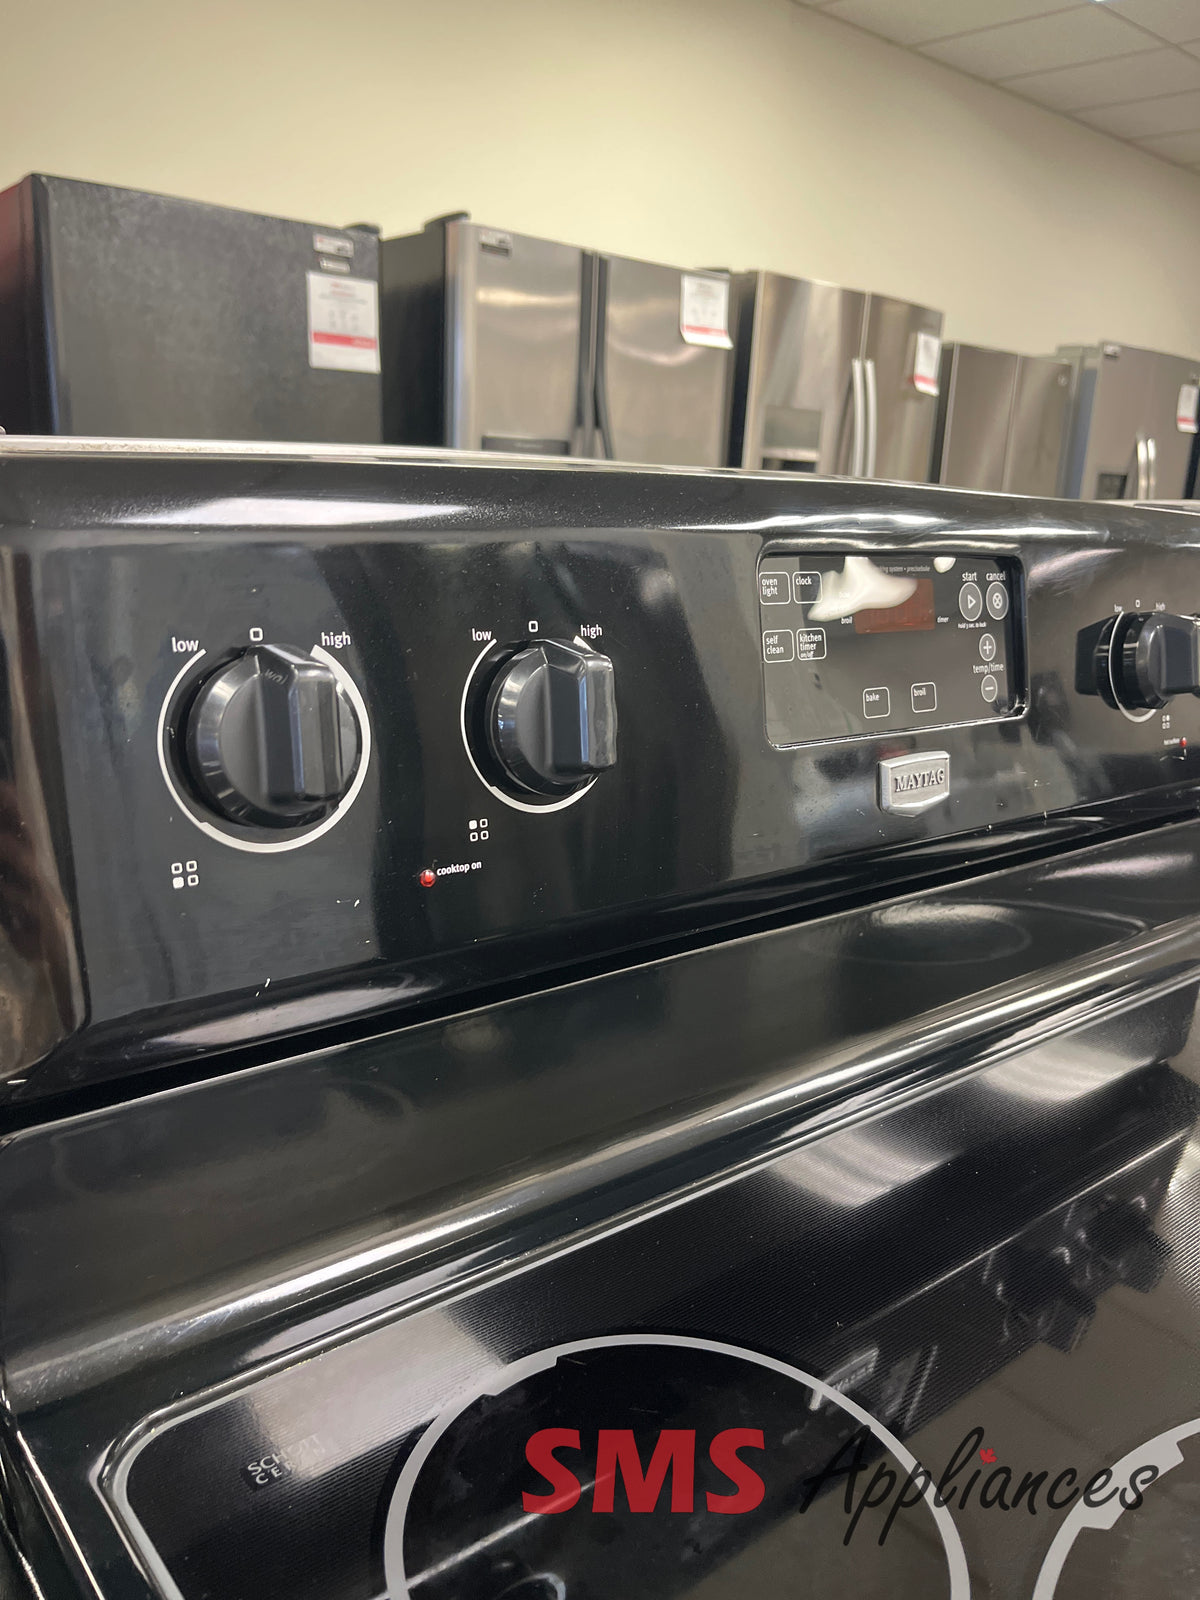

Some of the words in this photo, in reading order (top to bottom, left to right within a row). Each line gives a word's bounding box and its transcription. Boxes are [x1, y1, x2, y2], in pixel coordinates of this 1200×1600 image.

[795, 576, 812, 586] clock
[962, 571, 978, 582] start
[985, 570, 1006, 581] cancel
[761, 578, 778, 586] oven
[762, 586, 778, 597] light
[840, 616, 853, 624] broil
[471, 626, 492, 641] low
[579, 623, 603, 639] high
[320, 630, 352, 649] high
[766, 635, 779, 645] self
[799, 633, 822, 643] kitchen
[171, 635, 199, 653] low
[800, 643, 817, 651] timer
[766, 646, 784, 655] clean
[972, 661, 1004, 675] temp/time
[865, 693, 880, 701] bake
[913, 687, 926, 696] broil
[894, 768, 946, 793] MAYTAG
[436, 863, 470, 878] cooktop
[470, 860, 482, 871] on
